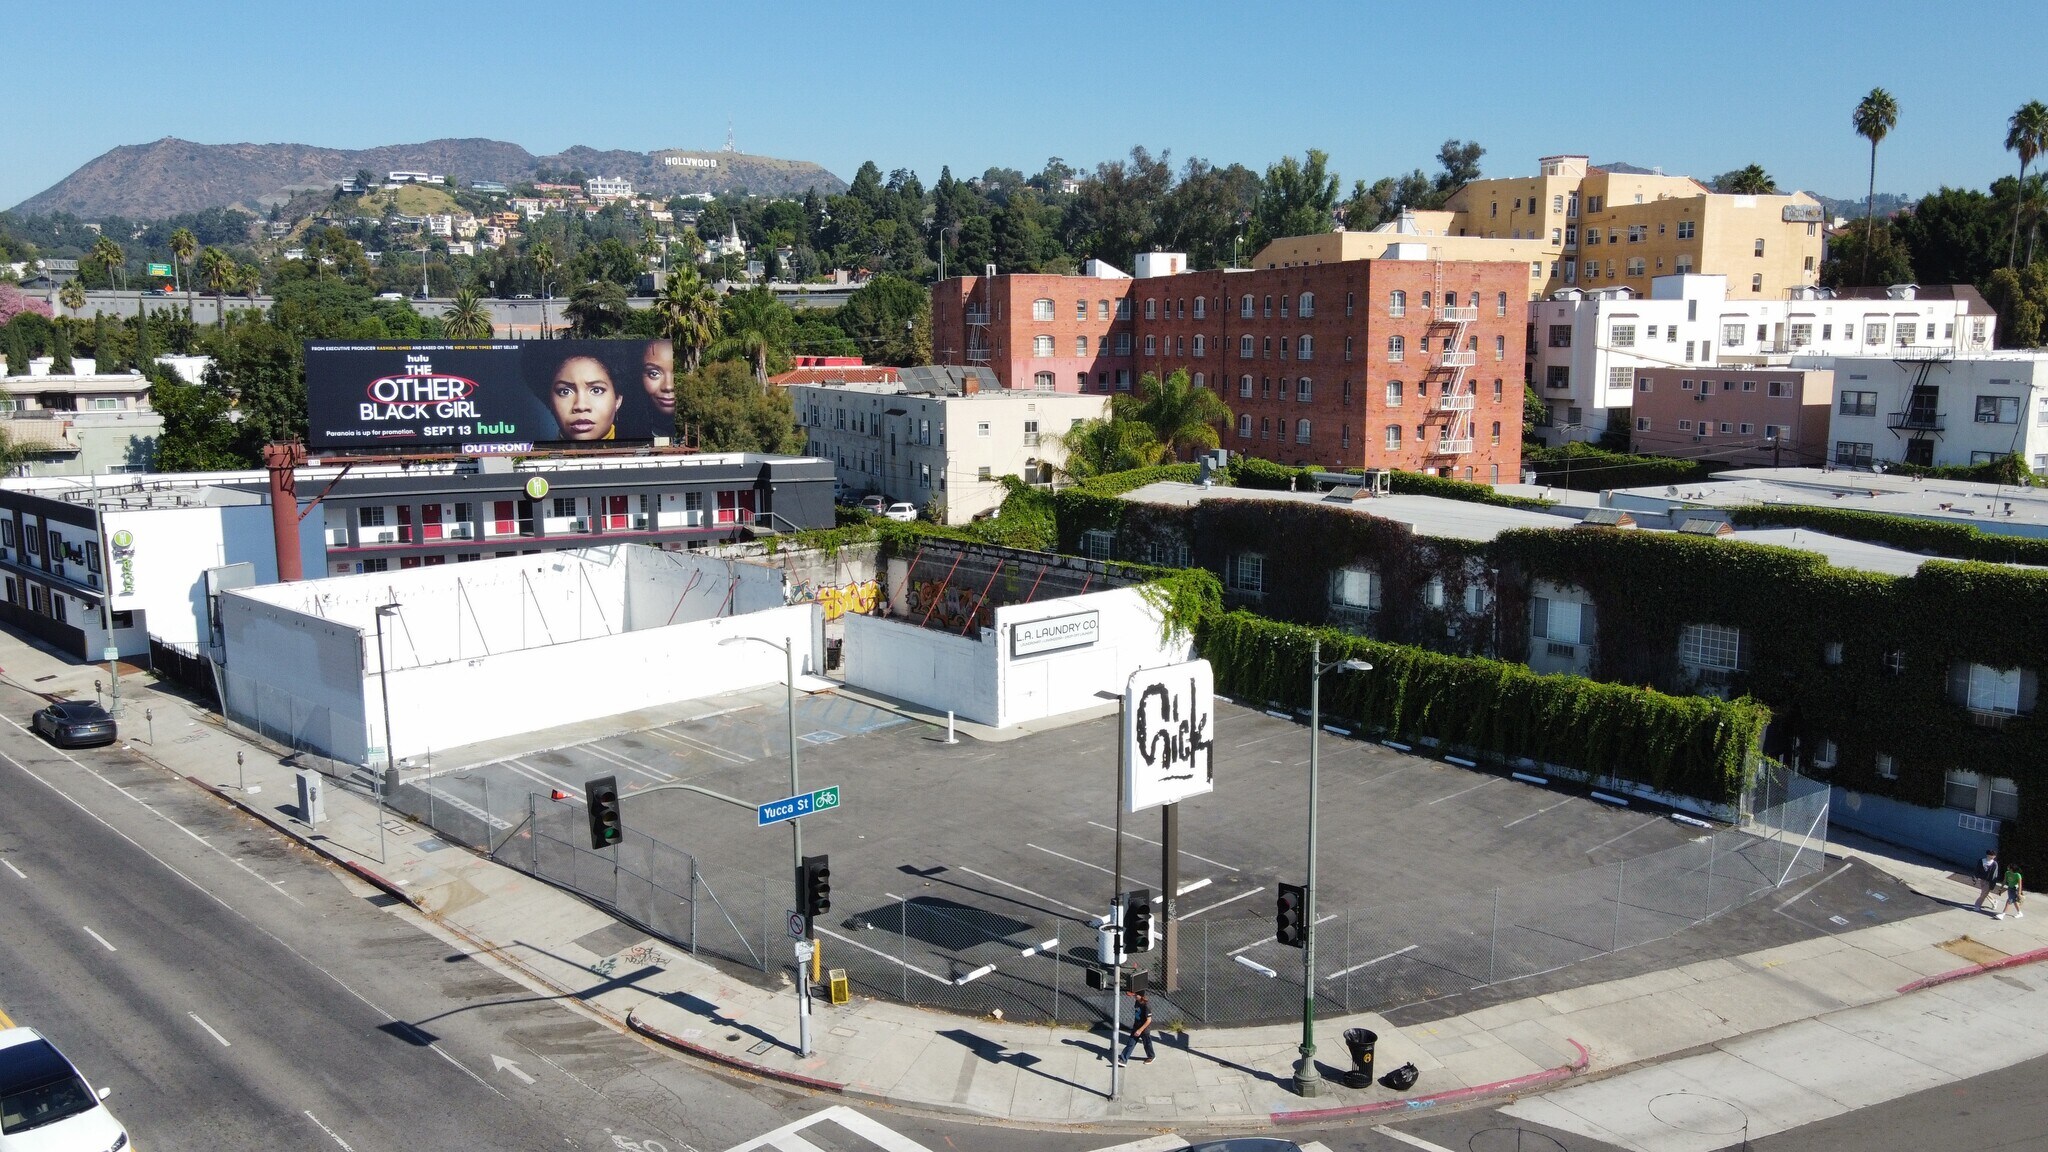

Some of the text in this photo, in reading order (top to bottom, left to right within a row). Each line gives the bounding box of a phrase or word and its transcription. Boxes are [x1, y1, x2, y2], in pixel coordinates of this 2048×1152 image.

[665, 157, 717, 167] HOLLYWOOD
[407, 354, 429, 362] hulu
[405, 364, 432, 375] THE
[374, 378, 465, 401] OTHER
[360, 401, 481, 420] BLACK GIRL
[382, 428, 416, 436] promotion.
[423, 425, 471, 436] SEPT 13
[477, 421, 515, 434] hulu
[1016, 630, 1034, 642] L.A.
[1036, 622, 1081, 639] LAUNDRY
[764, 798, 809, 819] Yucca St
